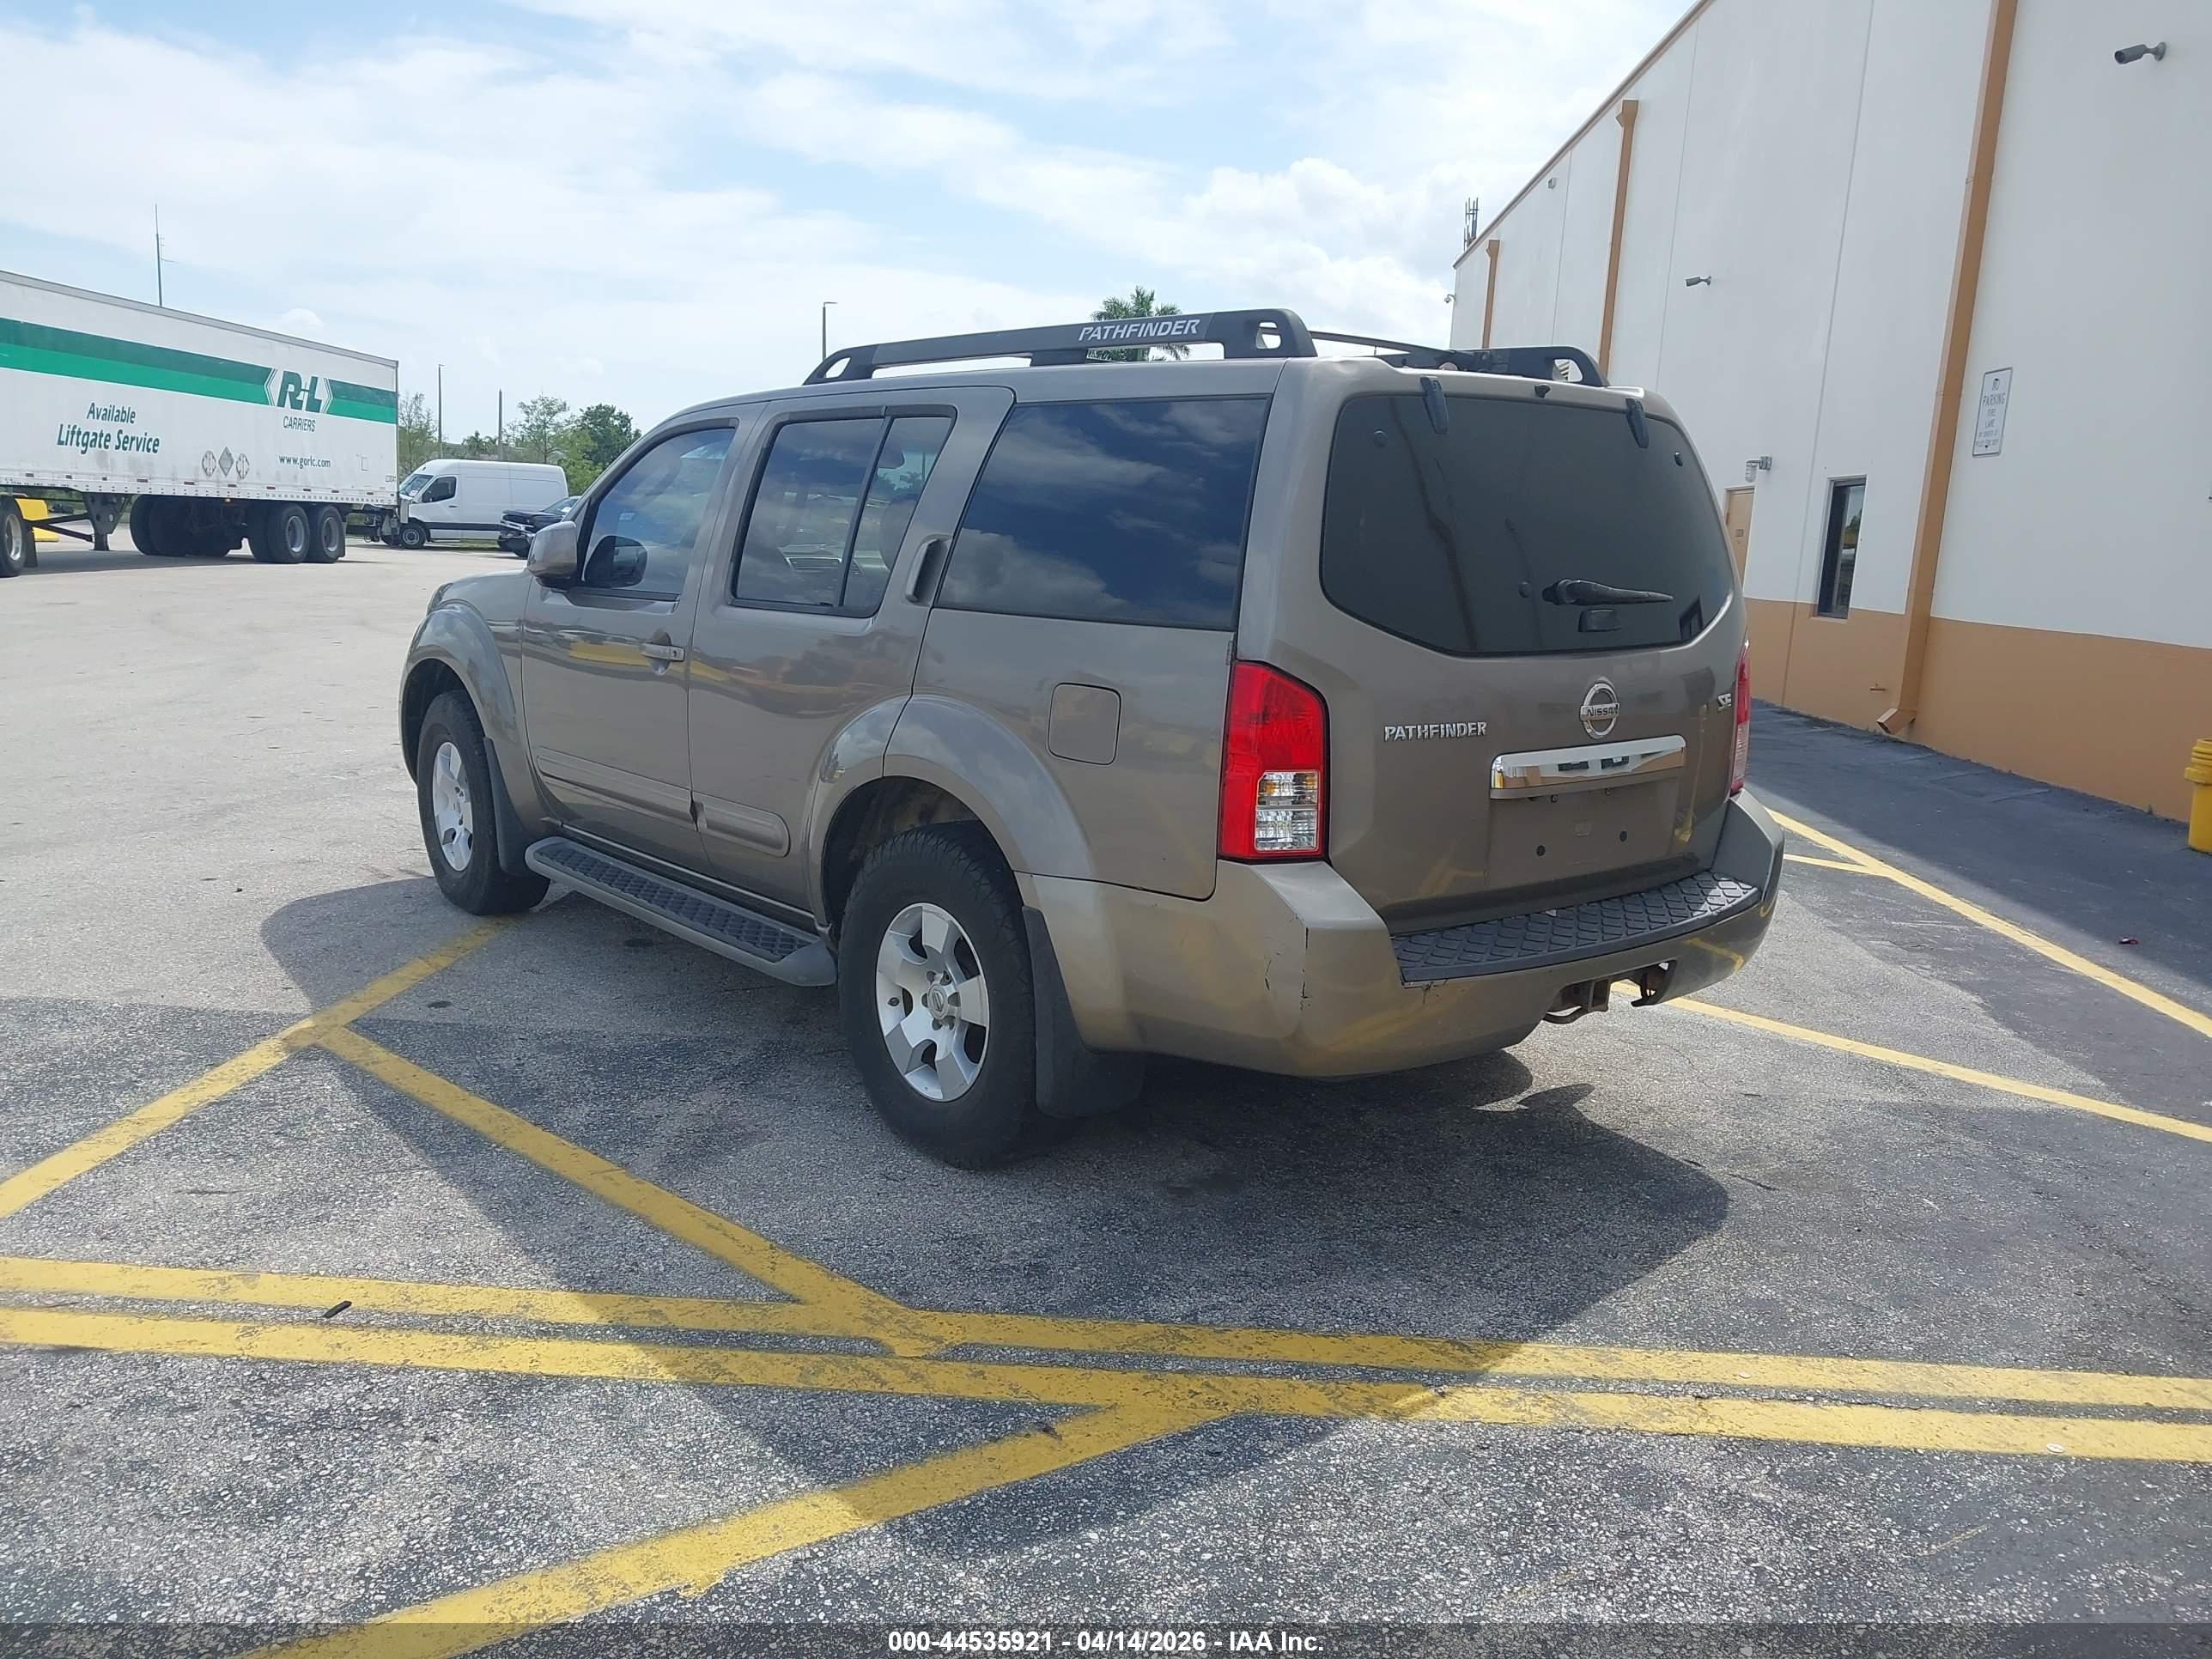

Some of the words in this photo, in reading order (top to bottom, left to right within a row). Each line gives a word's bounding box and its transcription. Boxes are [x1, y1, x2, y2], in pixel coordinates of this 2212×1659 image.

[1078, 319, 1200, 342] PATHFINDER
[1982, 392, 2006, 406] PARKING
[86, 402, 136, 424] Available
[283, 416, 316, 433] CARRIERS
[57, 423, 112, 455] Liftgate
[114, 428, 160, 453] Service
[278, 455, 331, 469] www.gorlc.com
[1717, 693, 1732, 709] SE
[1587, 704, 1619, 716] NISSAN
[1384, 721, 1487, 742] PATHFINDER
